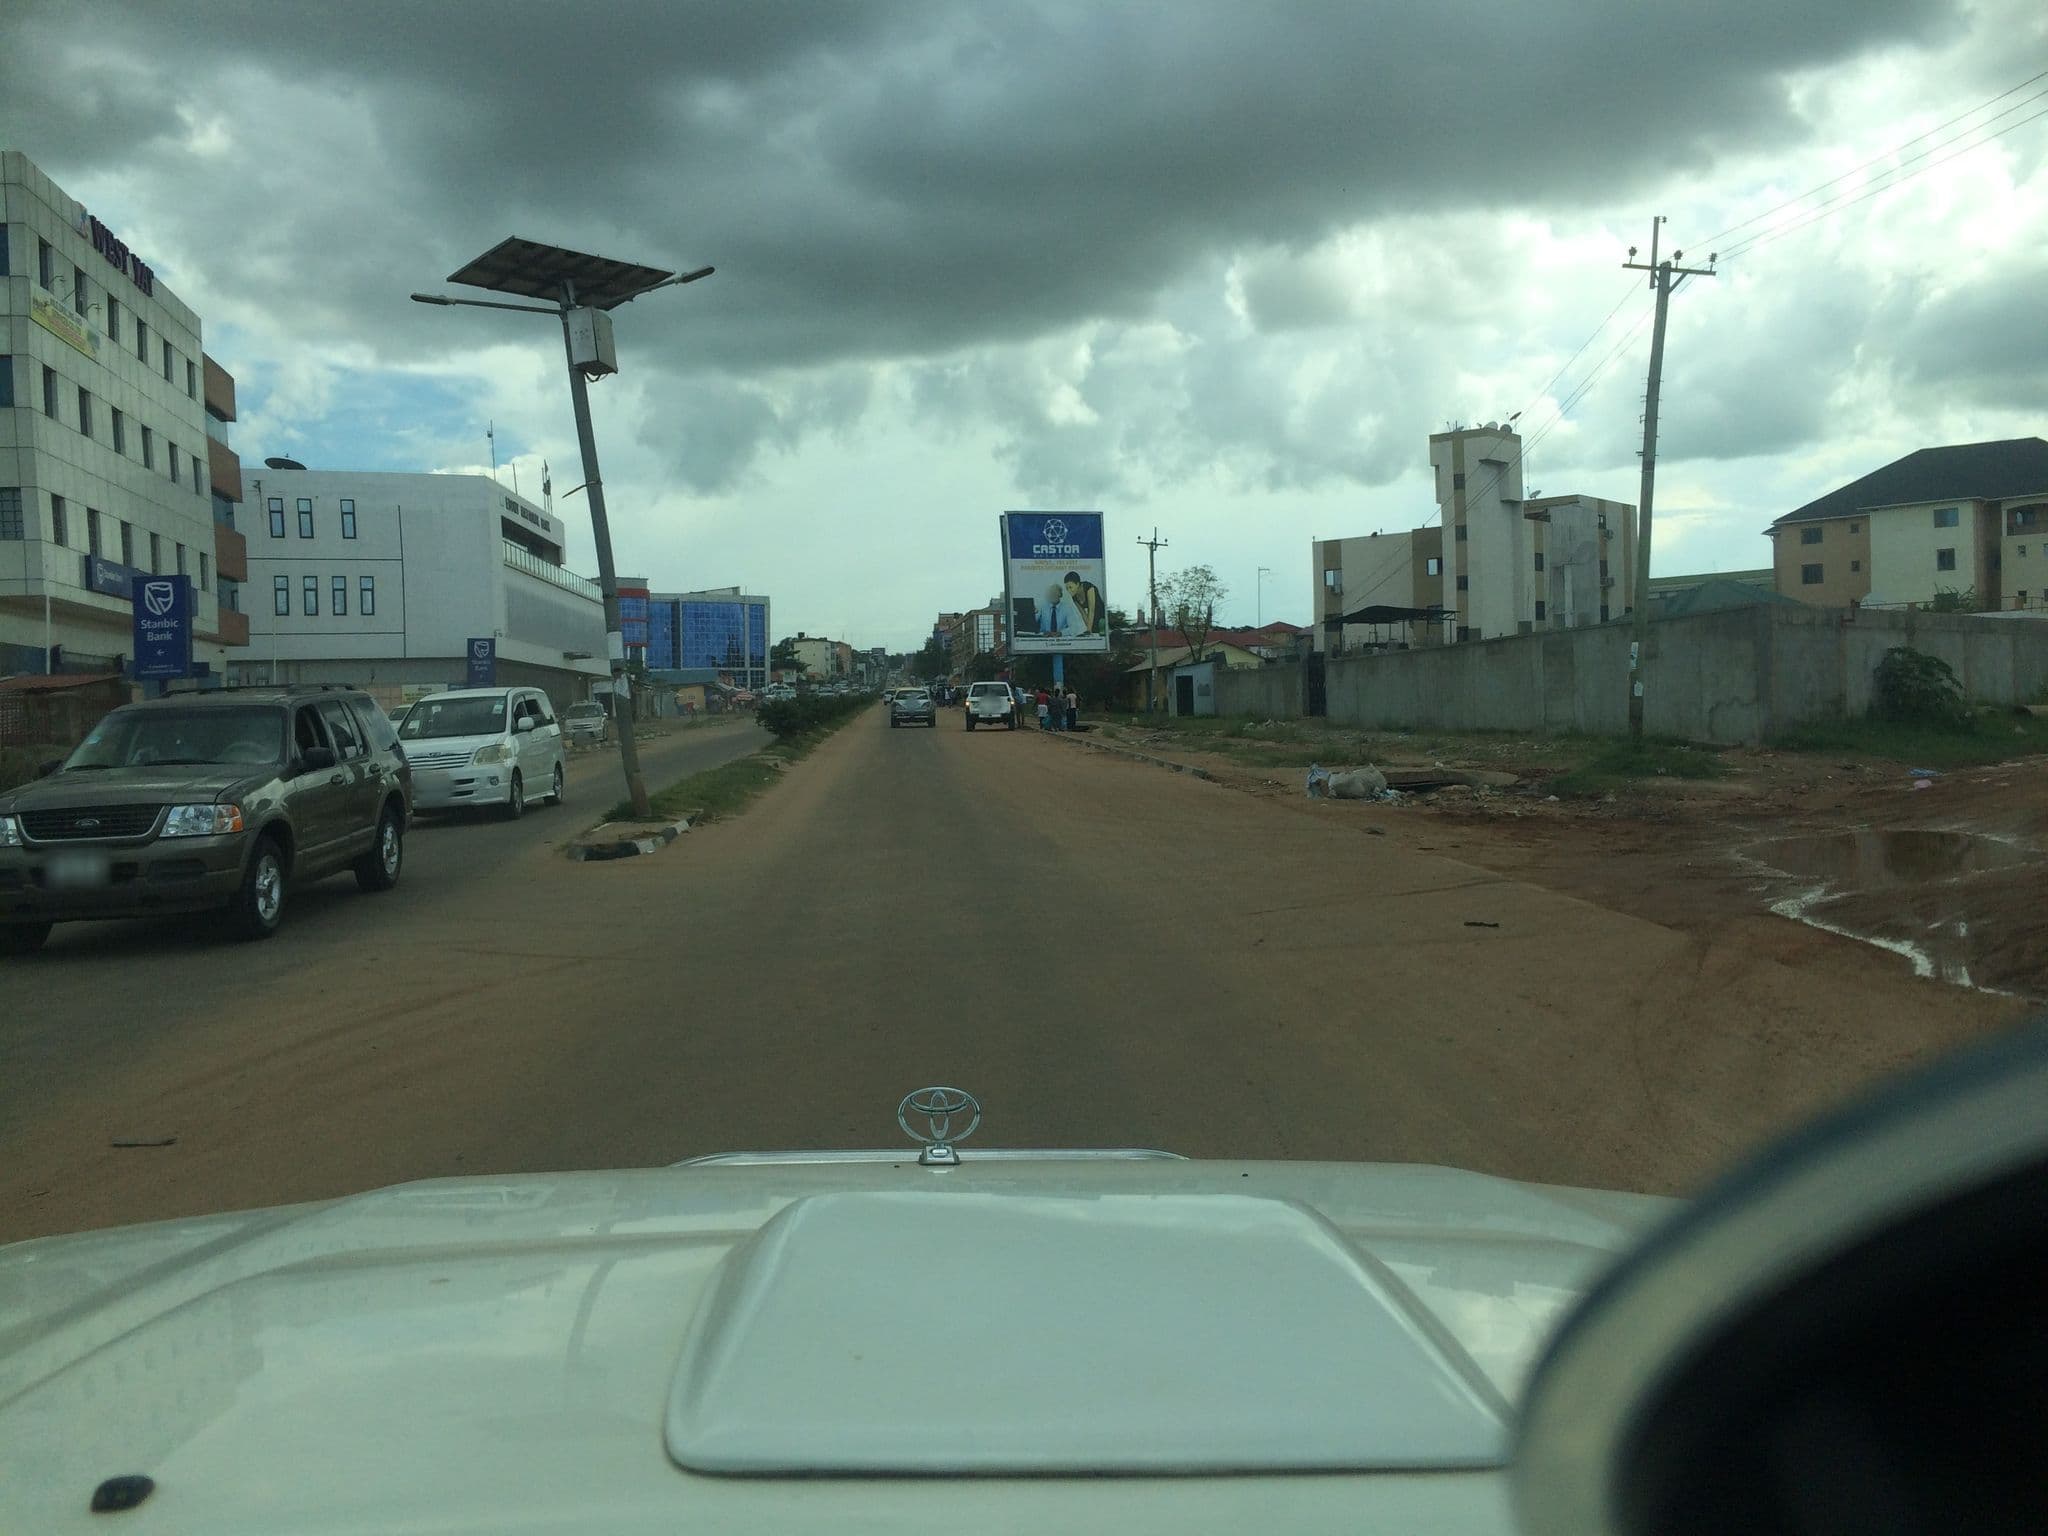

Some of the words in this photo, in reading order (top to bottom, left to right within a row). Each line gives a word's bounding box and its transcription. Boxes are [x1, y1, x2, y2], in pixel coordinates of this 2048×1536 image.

[1033, 545, 1080, 554] CASTOR
[140, 619, 179, 630] Stanbic
[146, 631, 174, 642] Bank
